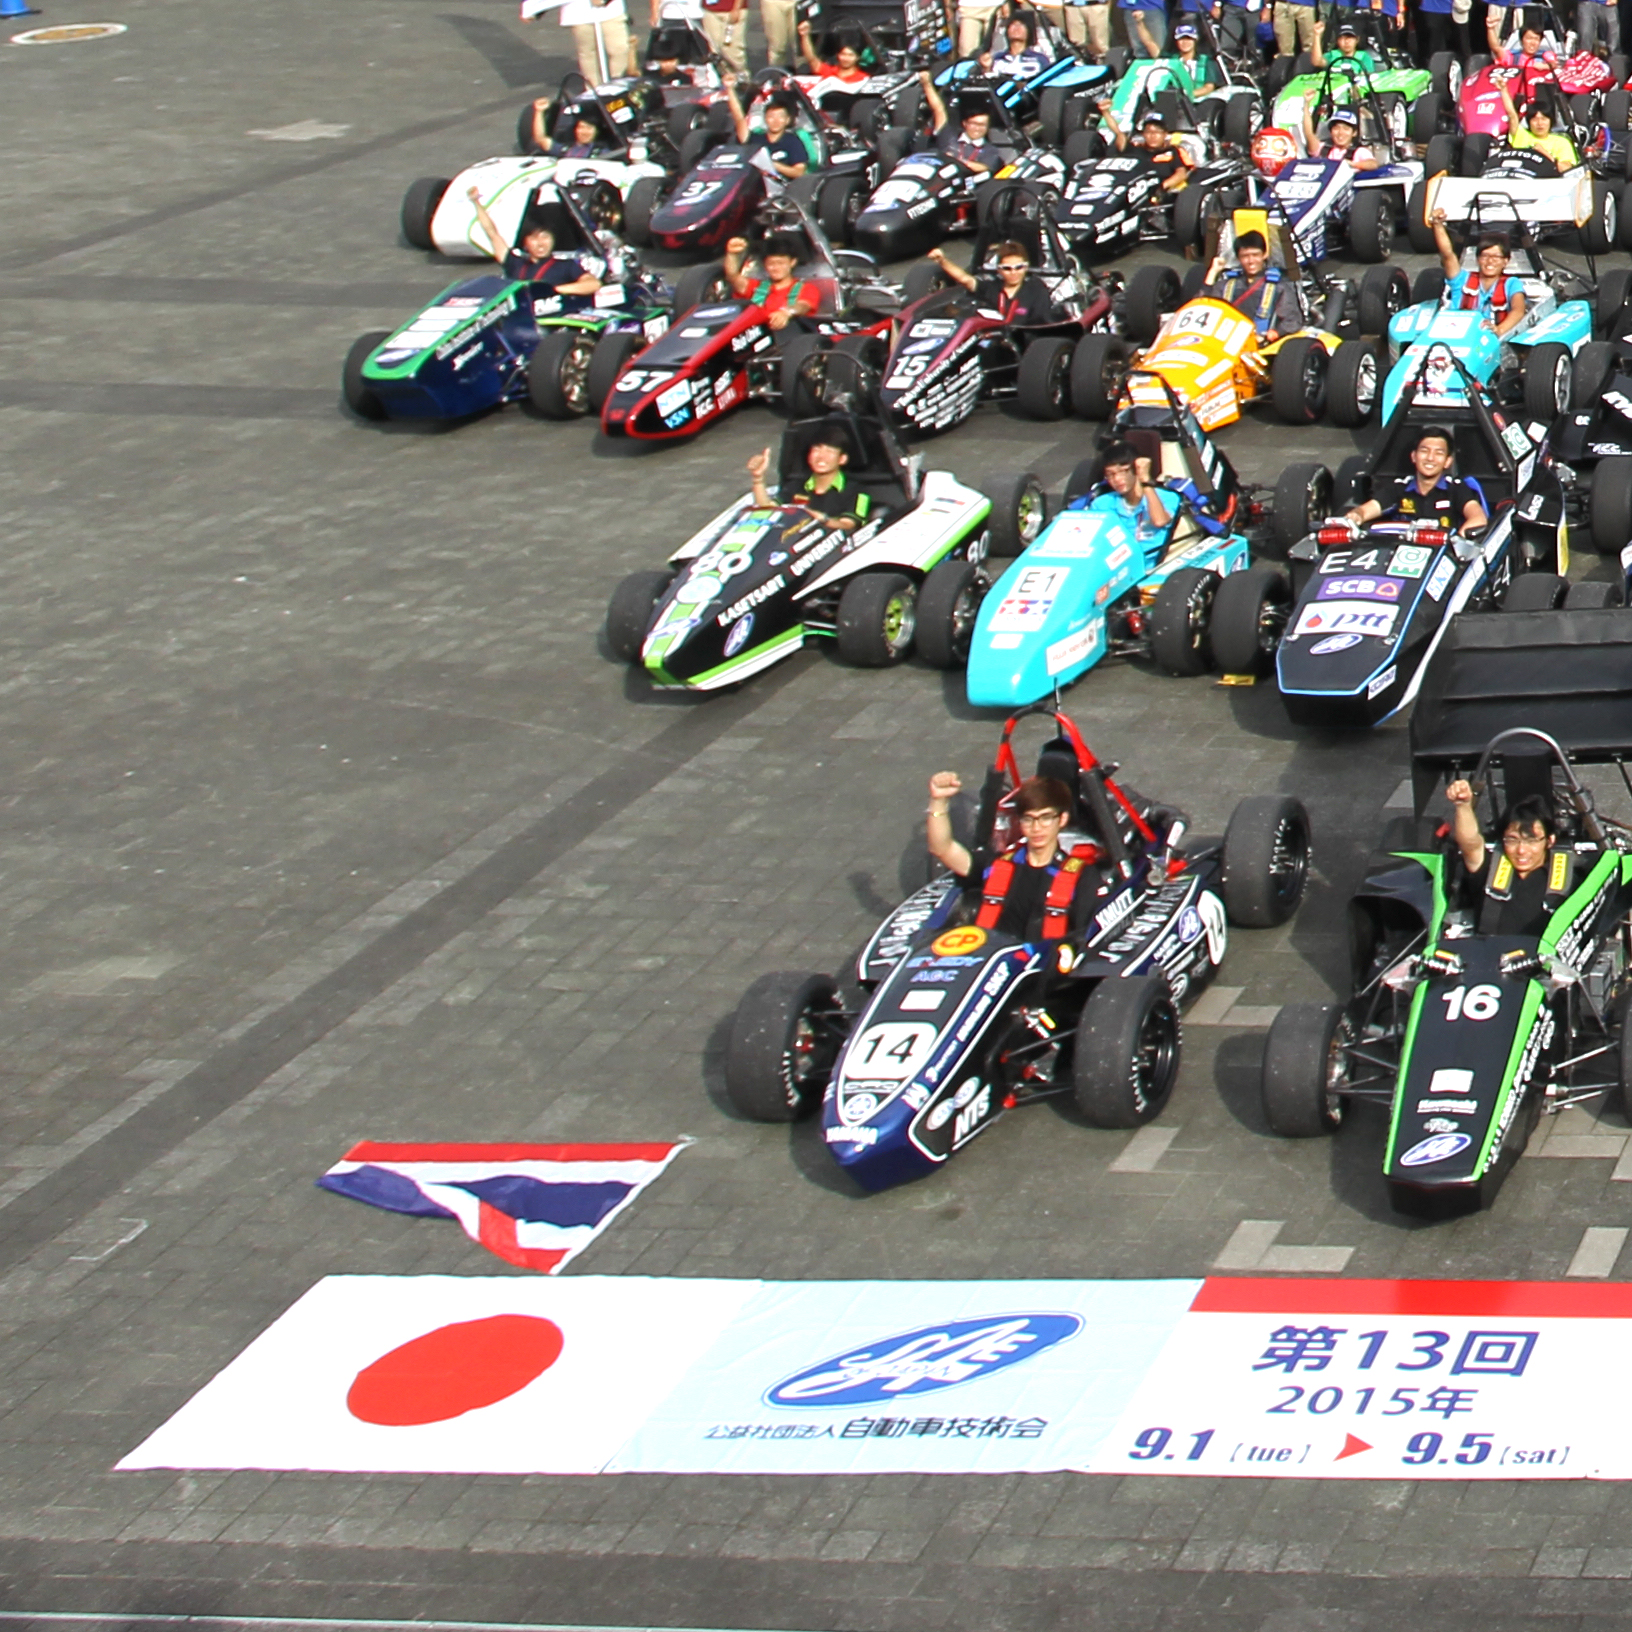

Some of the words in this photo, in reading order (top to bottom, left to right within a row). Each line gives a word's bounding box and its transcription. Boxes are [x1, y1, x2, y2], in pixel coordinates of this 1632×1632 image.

[681, 180, 724, 201] 37
[1175, 307, 1214, 330] 64
[615, 371, 674, 393] 57
[895, 356, 930, 377] 15
[789, 528, 846, 577] UNIVERSITY
[1318, 548, 1379, 574] E4
[1017, 570, 1061, 595] E1
[1327, 579, 1375, 595] SCB
[715, 573, 786, 628] KASETSART
[1332, 609, 1395, 629] ptt
[941, 931, 980, 949] CP
[1441, 984, 1503, 1023] 16
[865, 1031, 923, 1067] 14
[953, 1083, 992, 1143] NTS
[1254, 1324, 1541, 1378] 第13回
[1266, 1384, 1482, 1420] 2015年
[1129, 1425, 1216, 1463] 9.1
[1402, 1430, 1493, 1467] 9.5
